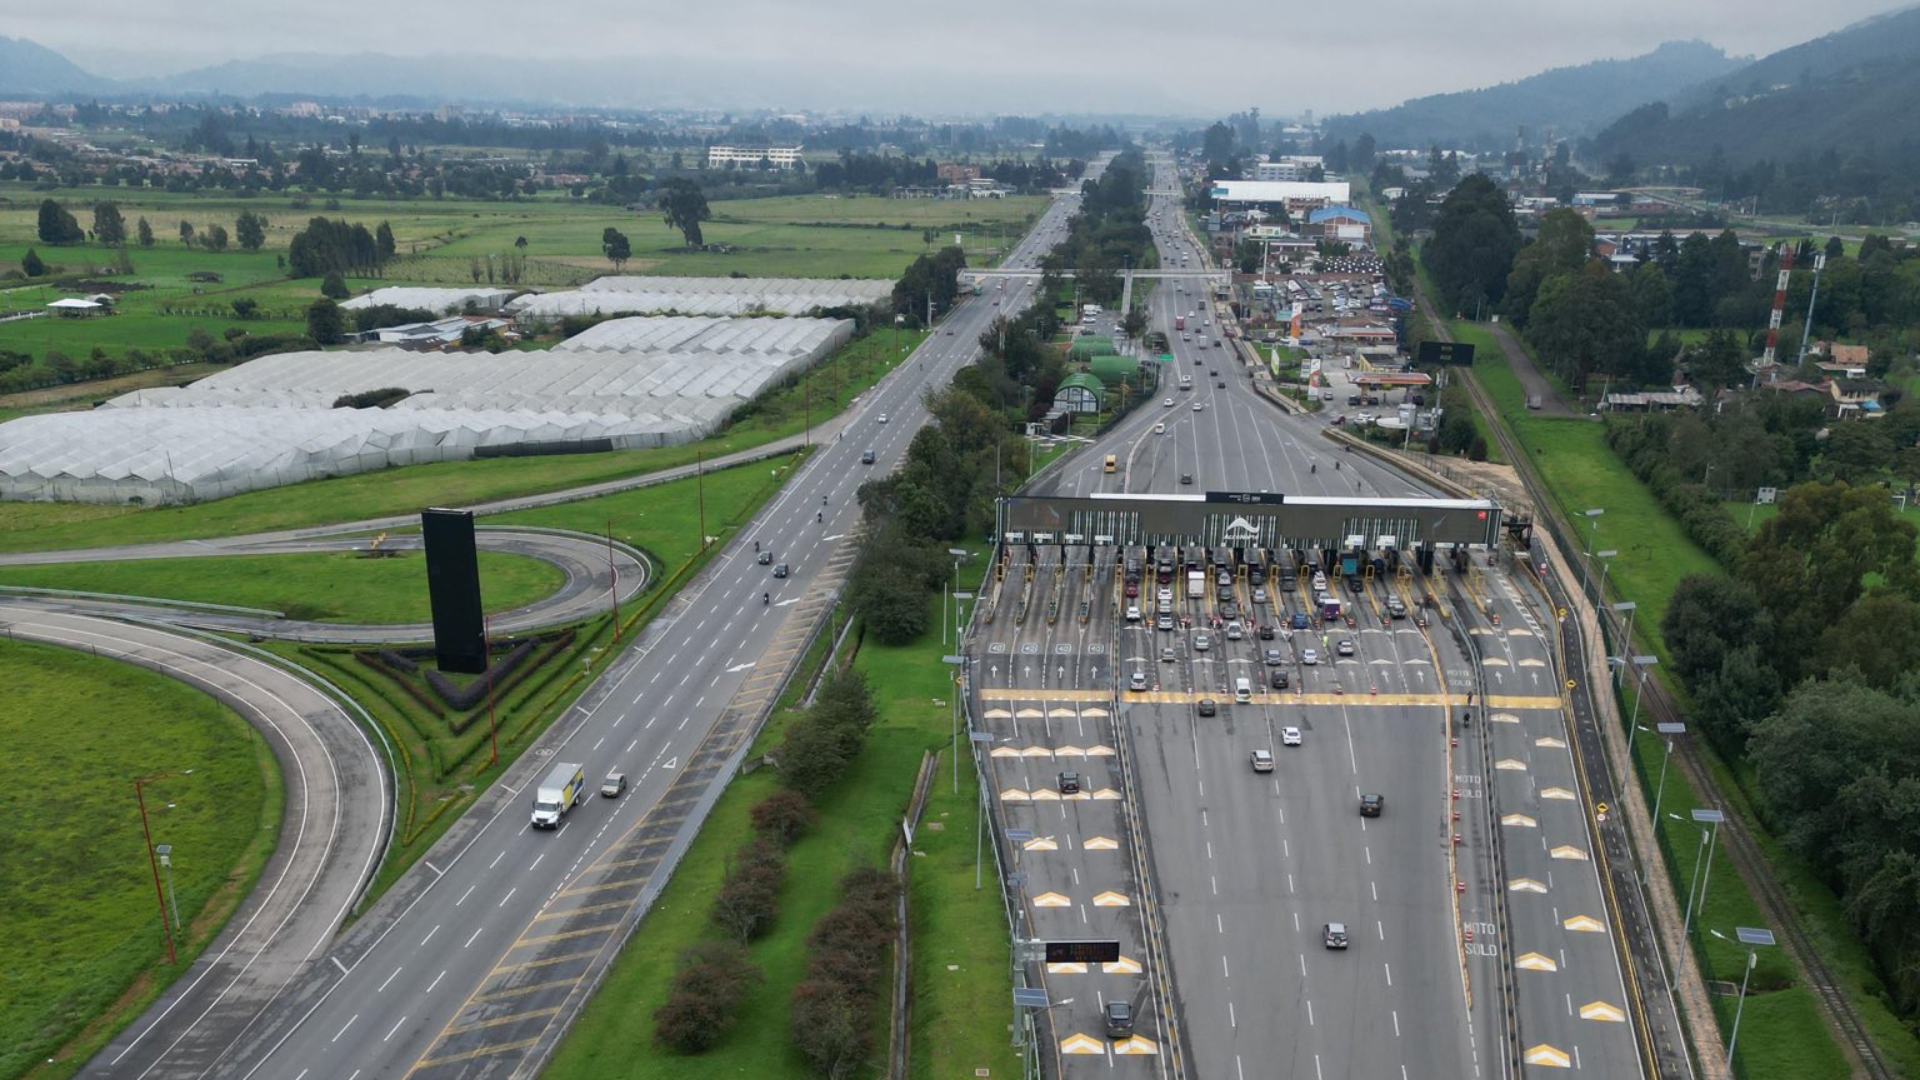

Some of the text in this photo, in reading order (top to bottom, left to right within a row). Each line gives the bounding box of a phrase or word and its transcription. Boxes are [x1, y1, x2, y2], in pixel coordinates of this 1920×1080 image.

[1455, 774, 1481, 784] MOTO
[1463, 921, 1496, 935] MOTO
[1464, 942, 1498, 956] SOLO
